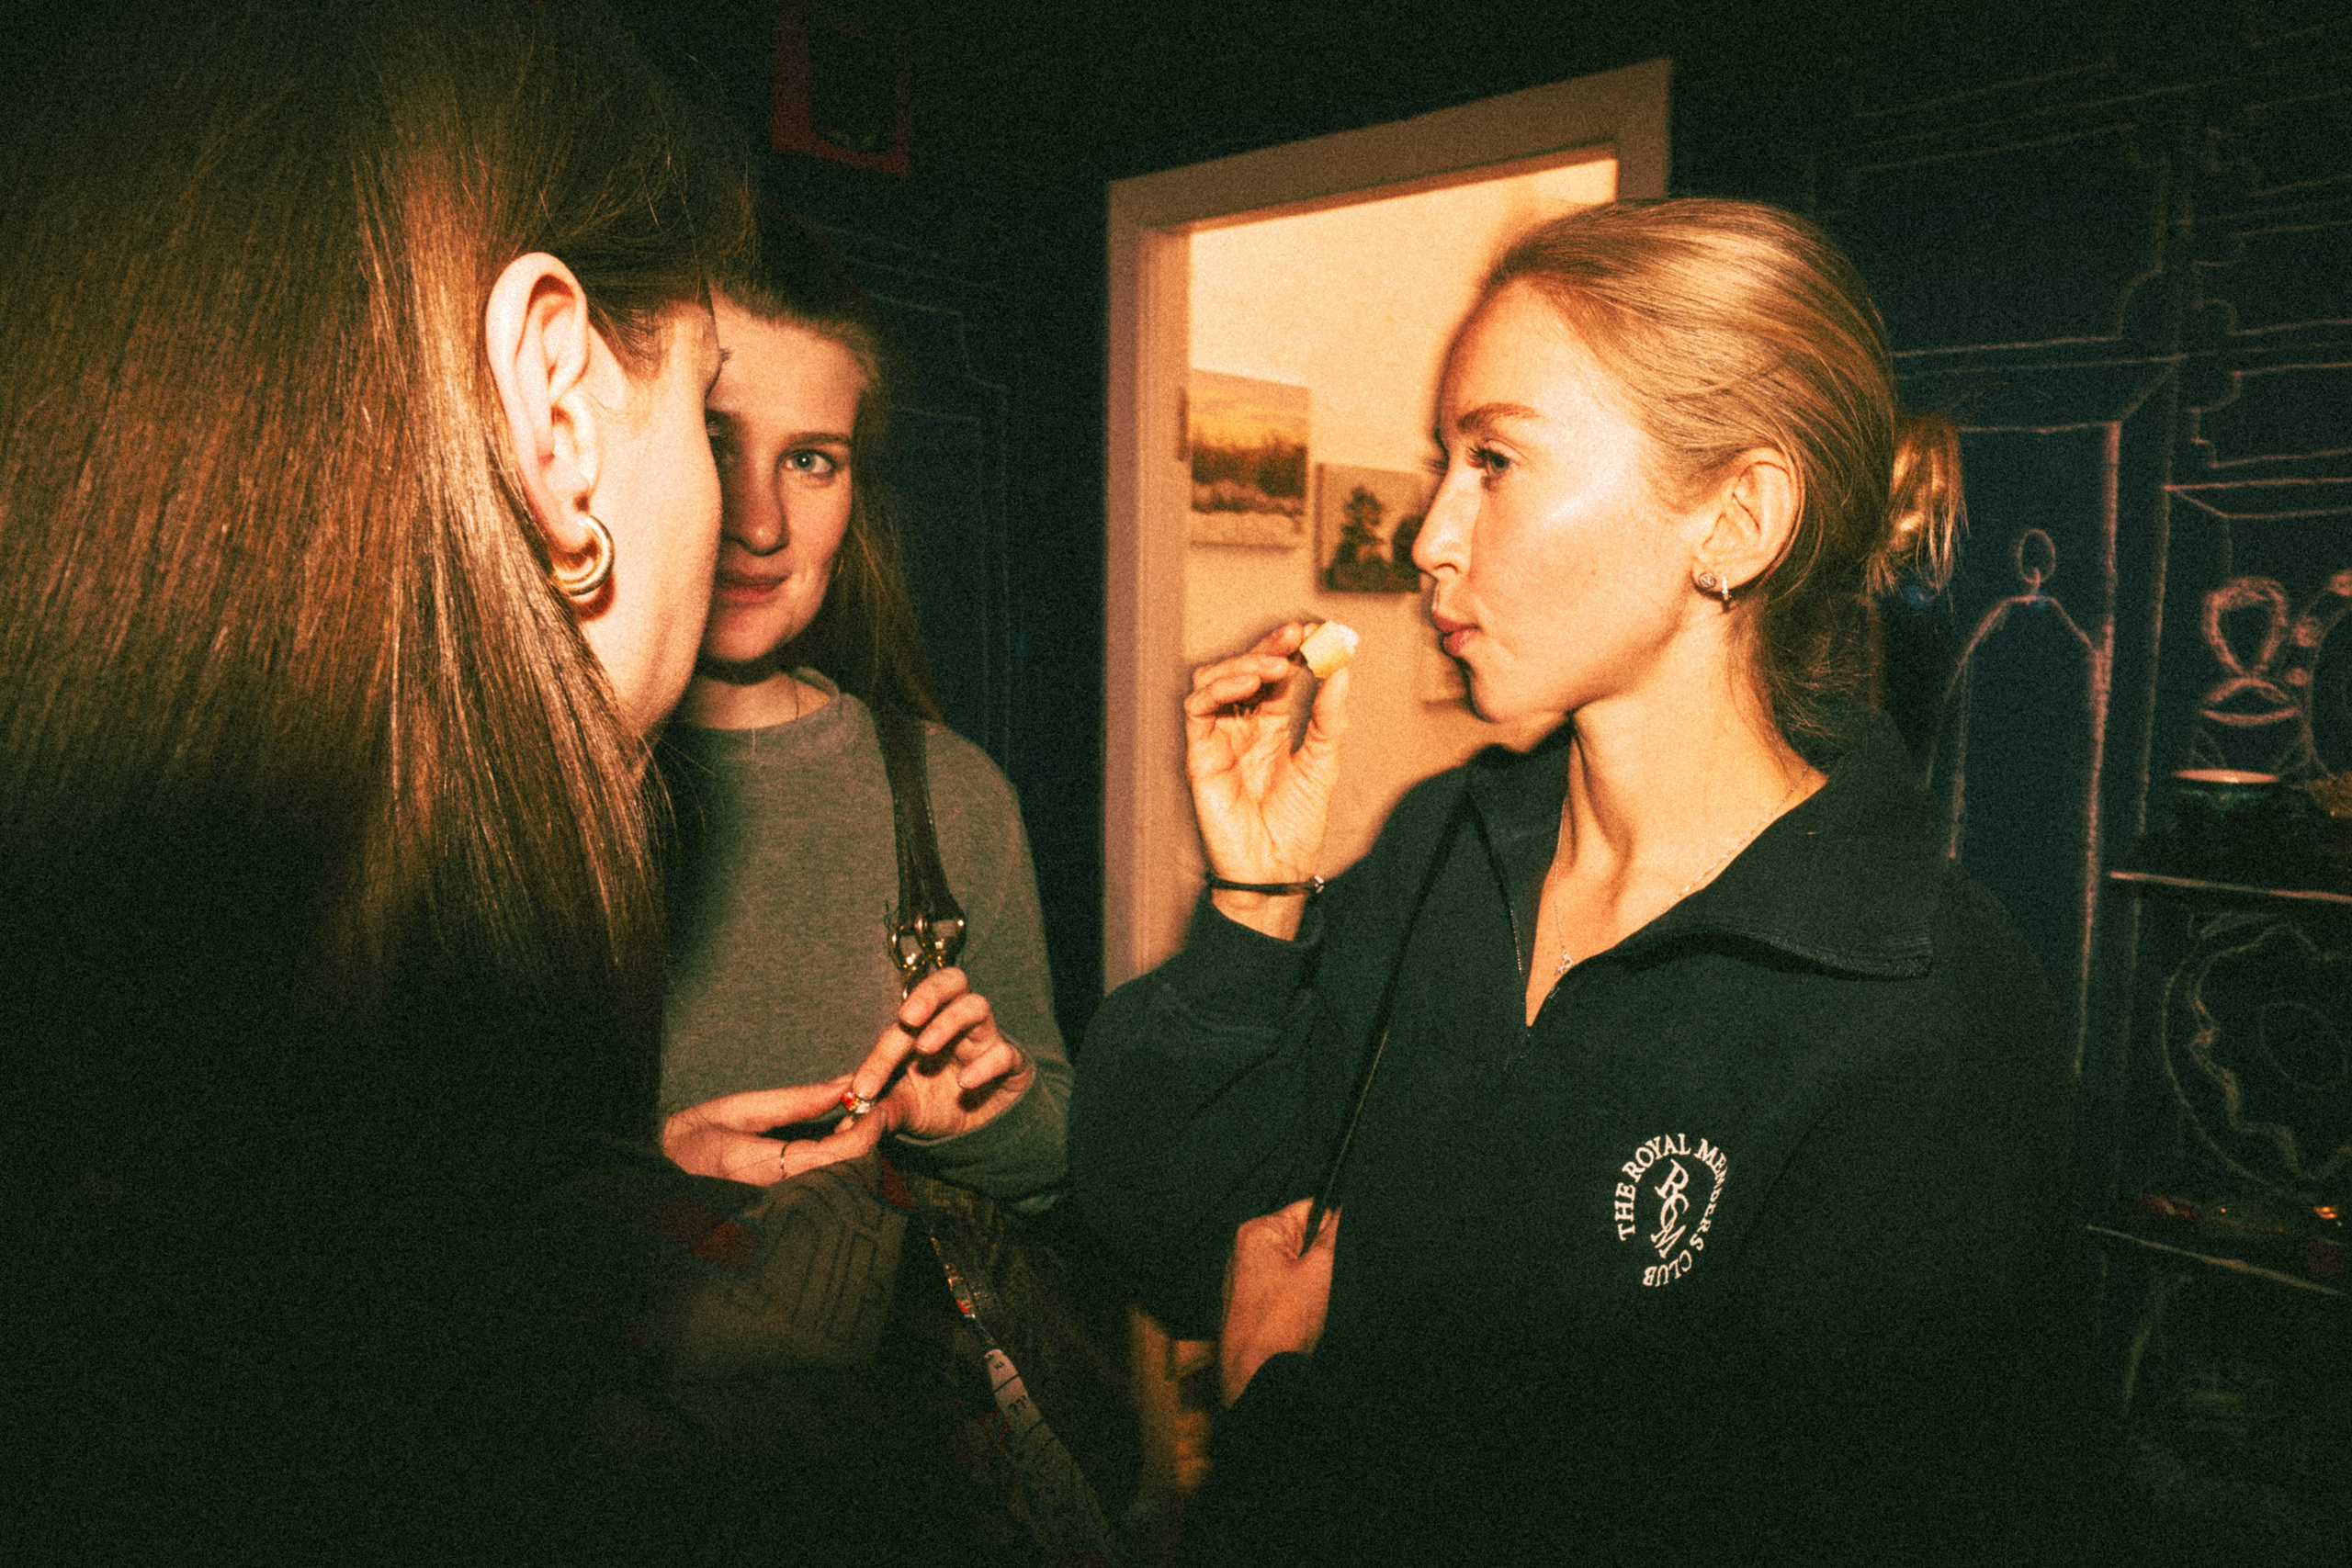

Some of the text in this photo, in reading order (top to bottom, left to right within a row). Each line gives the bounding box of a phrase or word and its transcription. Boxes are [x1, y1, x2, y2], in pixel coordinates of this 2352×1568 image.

[1621, 1133, 1692, 1184] ROYAL
[1614, 1181, 1637, 1242] THE
[1642, 1248, 1693, 1288] CLUB
